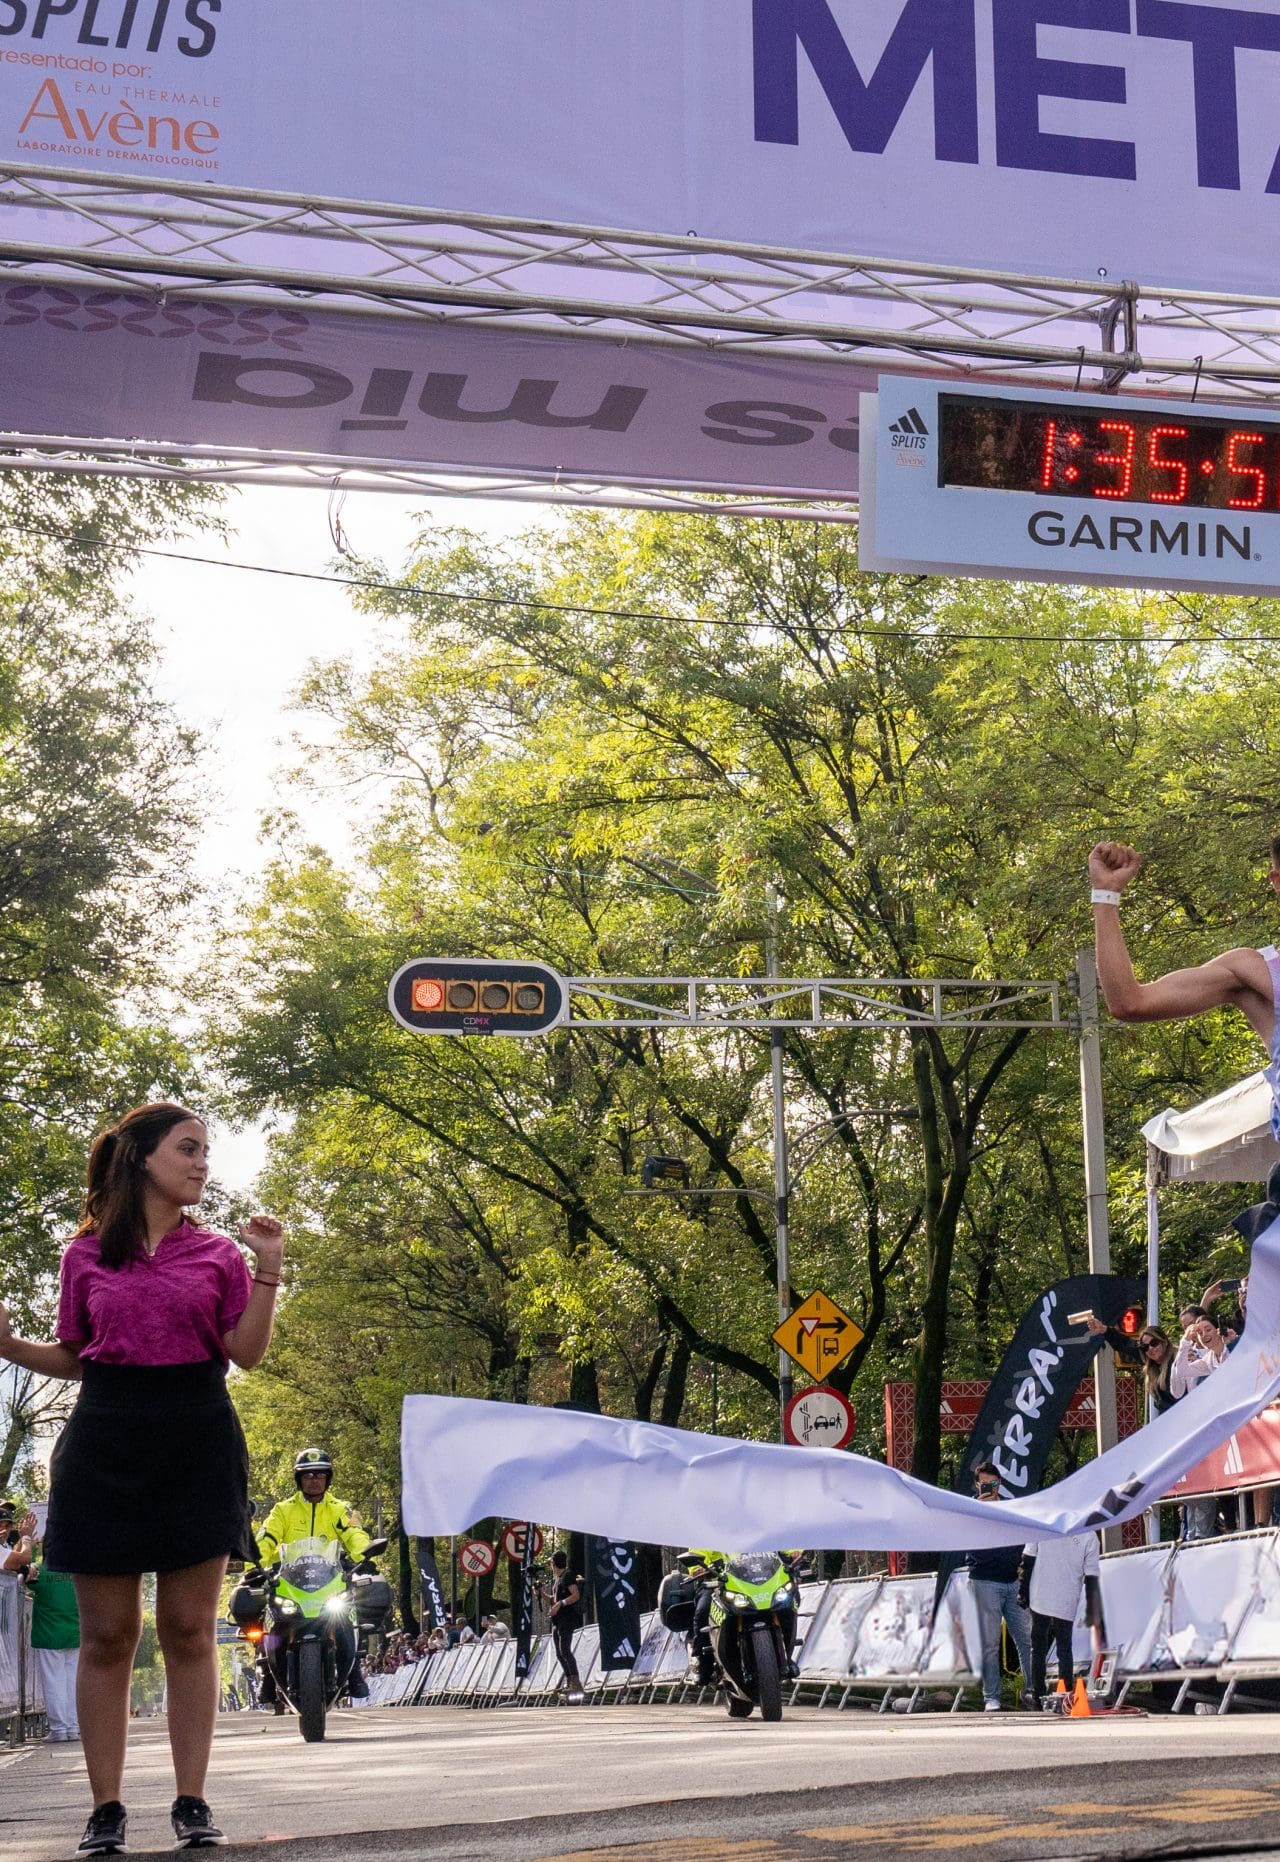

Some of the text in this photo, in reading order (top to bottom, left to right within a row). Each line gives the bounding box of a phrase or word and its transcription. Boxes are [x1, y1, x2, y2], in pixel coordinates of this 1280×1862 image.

[0, 50, 152, 78] resentado por:
[74, 81, 221, 108] EAU THERMALE
[18, 78, 220, 154] Avène
[17, 140, 220, 169] LABORATOIRE DERMATOLOGIQUE
[891, 434, 927, 449] SPLITS
[463, 1017, 490, 1025] CDMX
